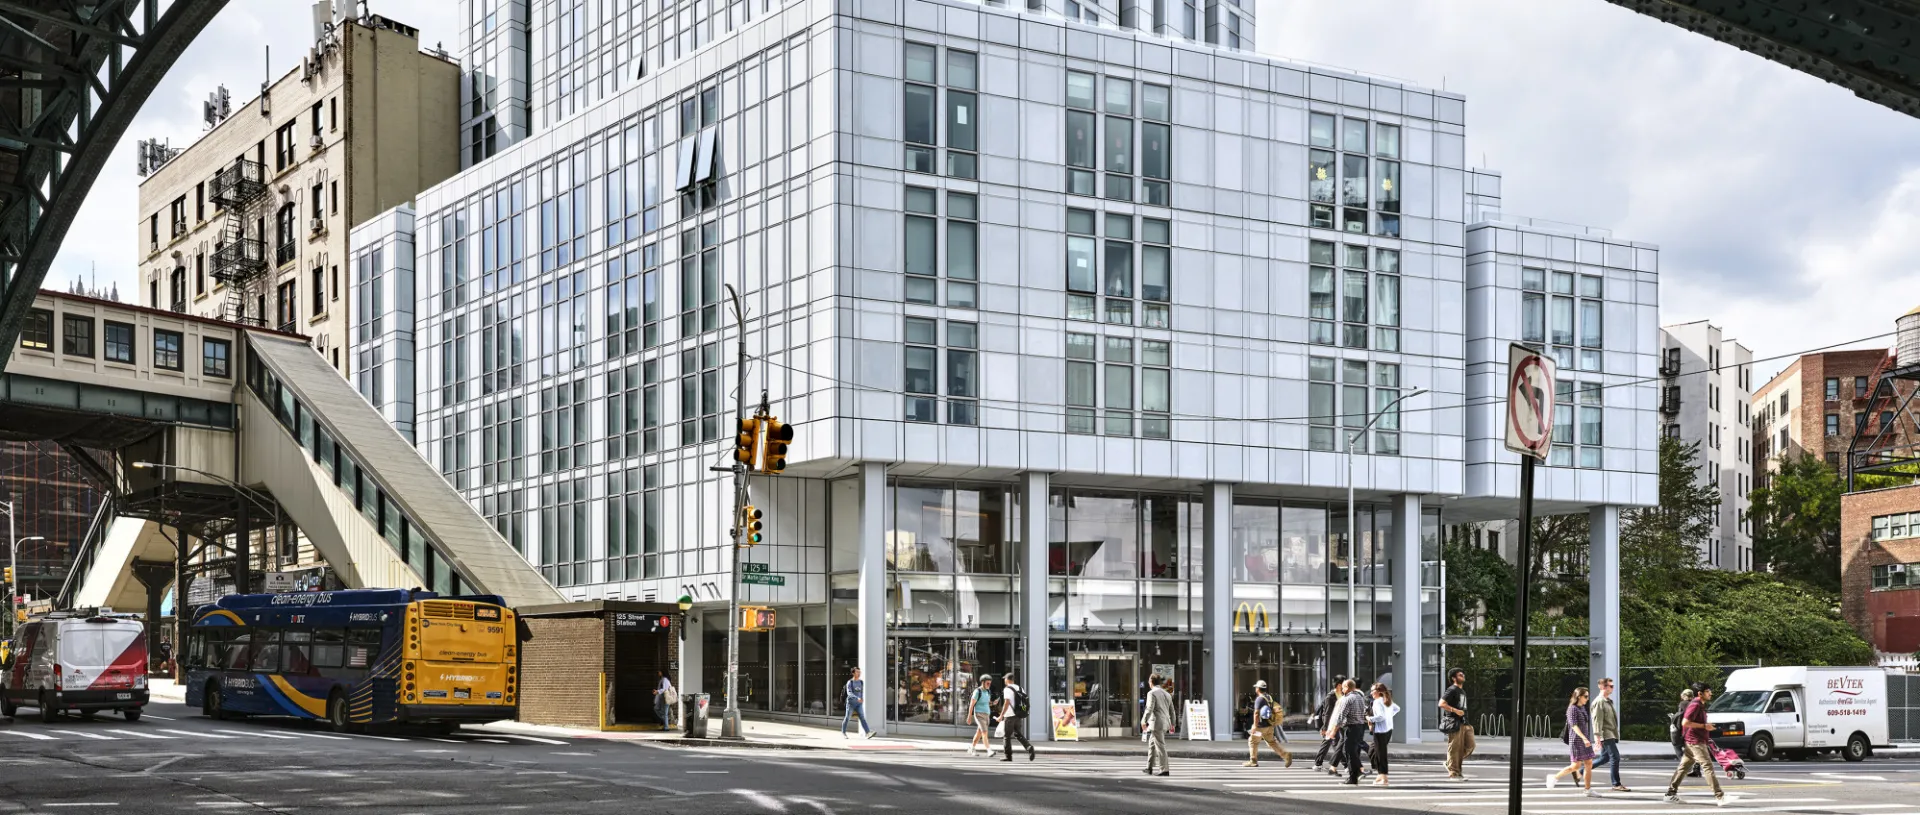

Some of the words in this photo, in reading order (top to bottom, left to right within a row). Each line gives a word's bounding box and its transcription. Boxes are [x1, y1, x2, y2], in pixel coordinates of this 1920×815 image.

[750, 564, 761, 572] 125
[271, 593, 317, 606] clean-energy
[317, 592, 333, 604] bus
[352, 612, 378, 622] HYBRIDBUS
[767, 613, 775, 626] 13
[1234, 601, 1270, 632] M
[487, 626, 504, 634] 9591
[446, 674, 486, 682] HYBRIDBUS
[227, 678, 255, 688] HYBRIDBUS
[1867, 698, 1877, 706] Agent
[1827, 708, 1866, 716] 609-518-1419
